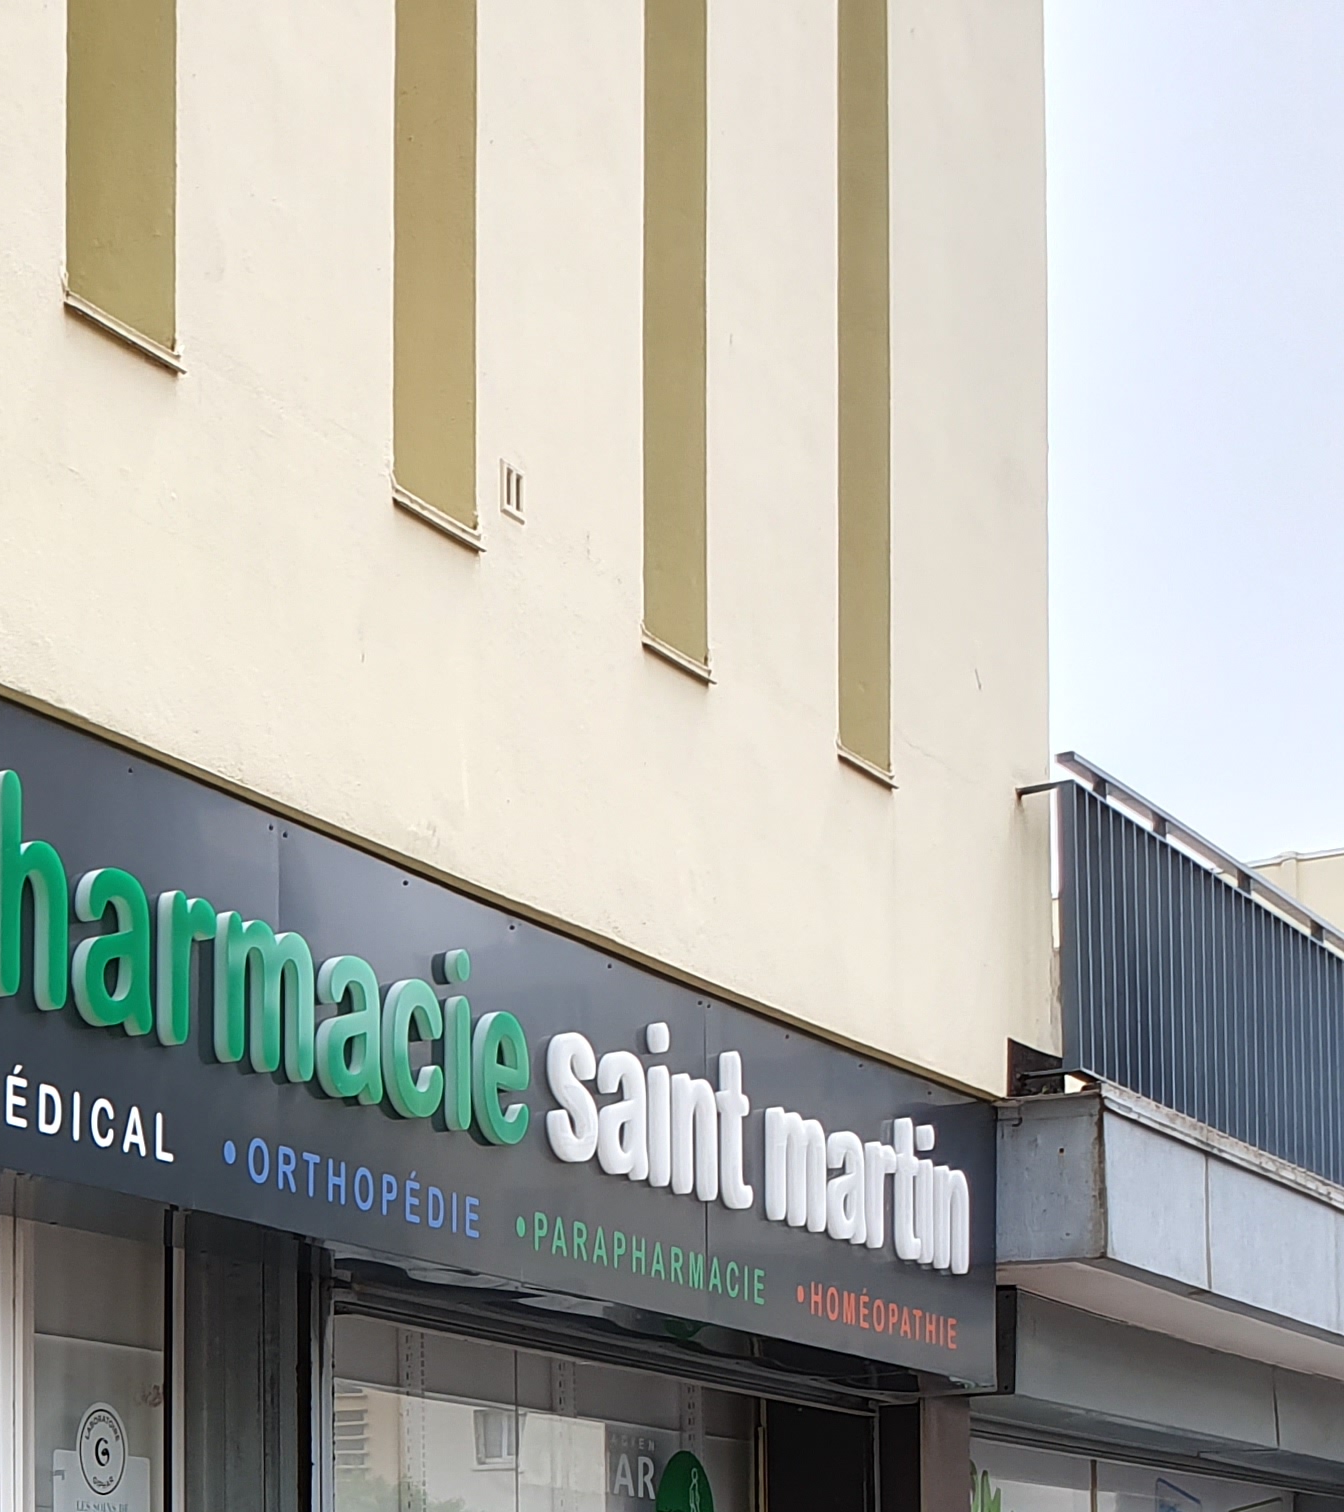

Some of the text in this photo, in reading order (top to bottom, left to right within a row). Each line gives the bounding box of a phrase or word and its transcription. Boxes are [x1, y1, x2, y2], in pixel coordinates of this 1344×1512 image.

[247, 1136, 481, 1239] ORTHOPÉDIE
[545, 1021, 971, 1276] saint martin
[533, 1213, 767, 1306] PARAPHARMACIE
[809, 1281, 958, 1351] HOMÉOPATHIE
[76, 1500, 91, 1512] LES
[93, 1502, 116, 1512] SOINS
